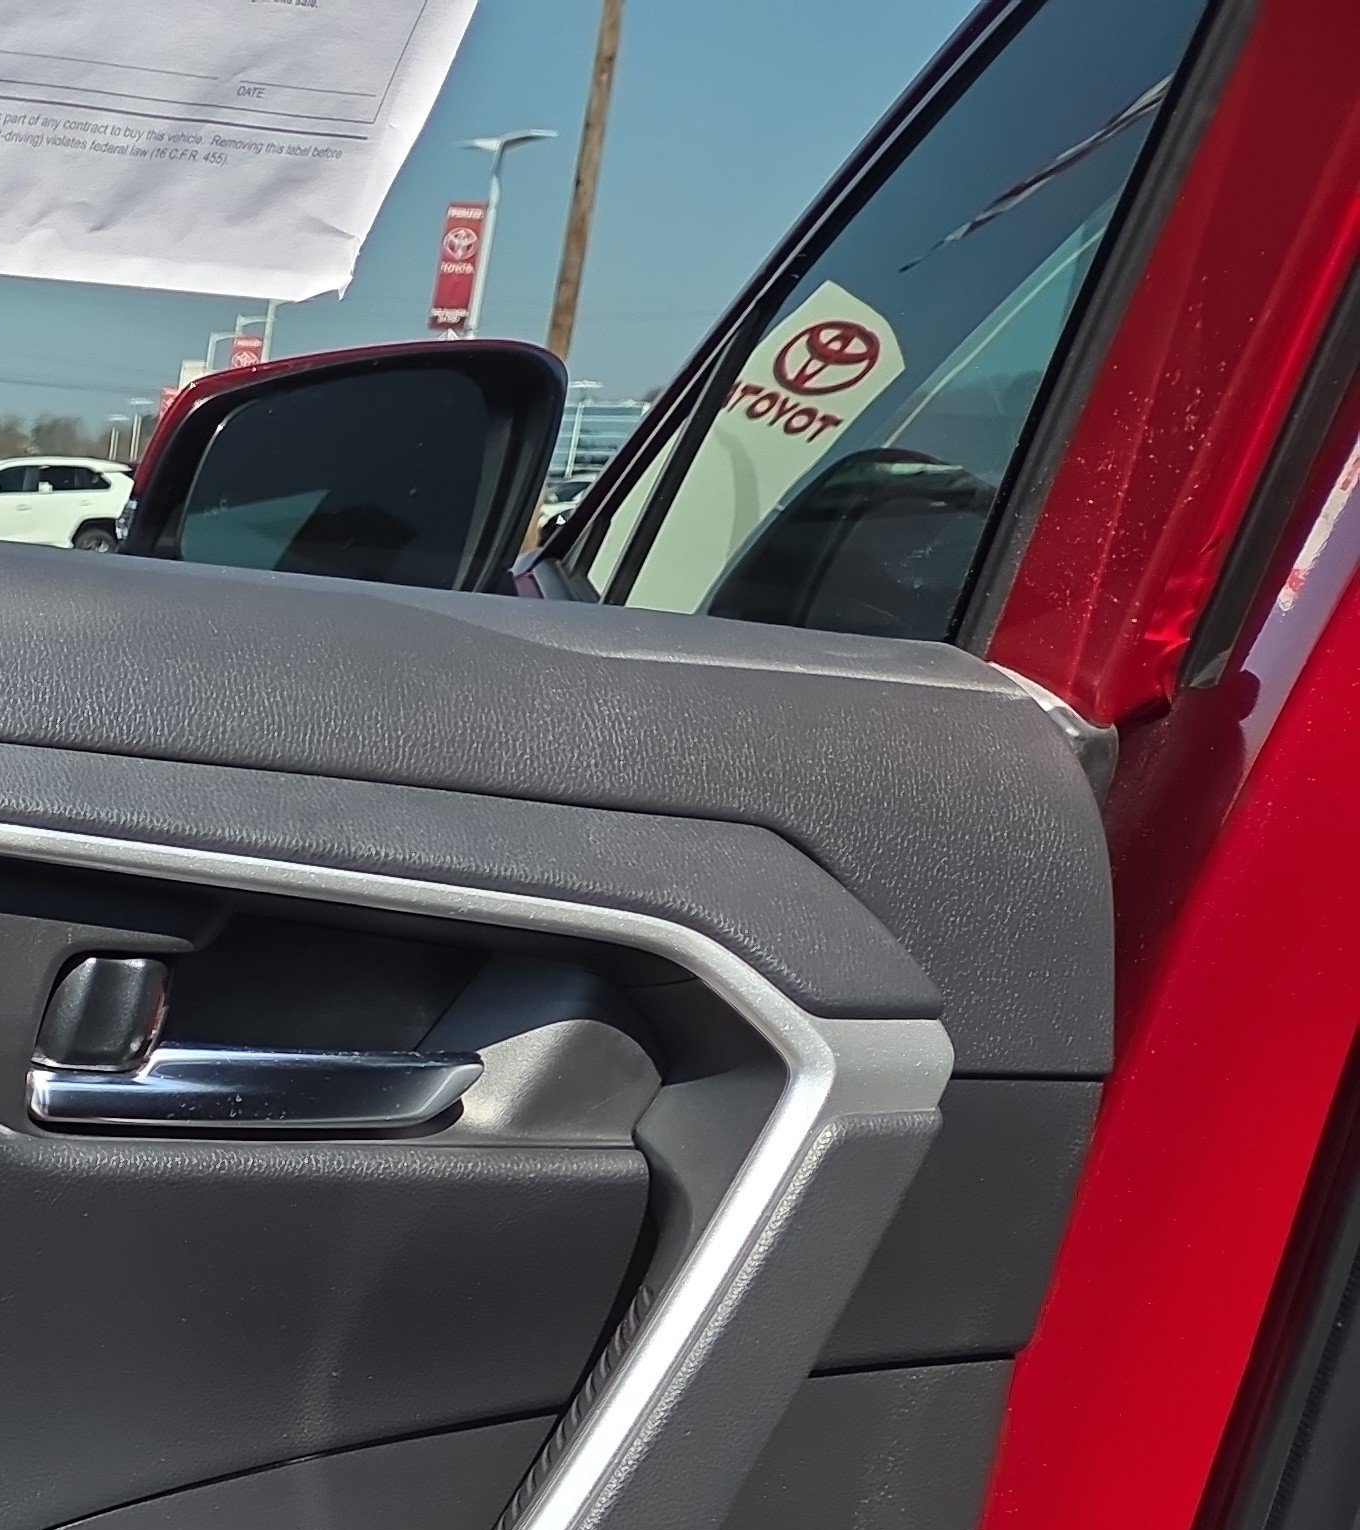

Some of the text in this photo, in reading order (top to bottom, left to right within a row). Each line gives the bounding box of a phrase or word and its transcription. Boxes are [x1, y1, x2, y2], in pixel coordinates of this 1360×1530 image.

[236, 85, 266, 98] DATE
[3, 112, 27, 127] part
[28, 114, 41, 126] of
[41, 118, 61, 131] any
[62, 118, 109, 136] contract
[110, 124, 121, 137] to
[123, 126, 145, 142] buy
[146, 129, 165, 142] this
[211, 134, 264, 154] Removing
[266, 141, 286, 155] this
[286, 144, 311, 158] label
[312, 145, 343, 160] before
[46, 134, 87, 150] violates
[89, 139, 130, 156] federal
[131, 144, 149, 158] law
[149, 146, 168, 161] (16
[202, 152, 228, 168] 455).
